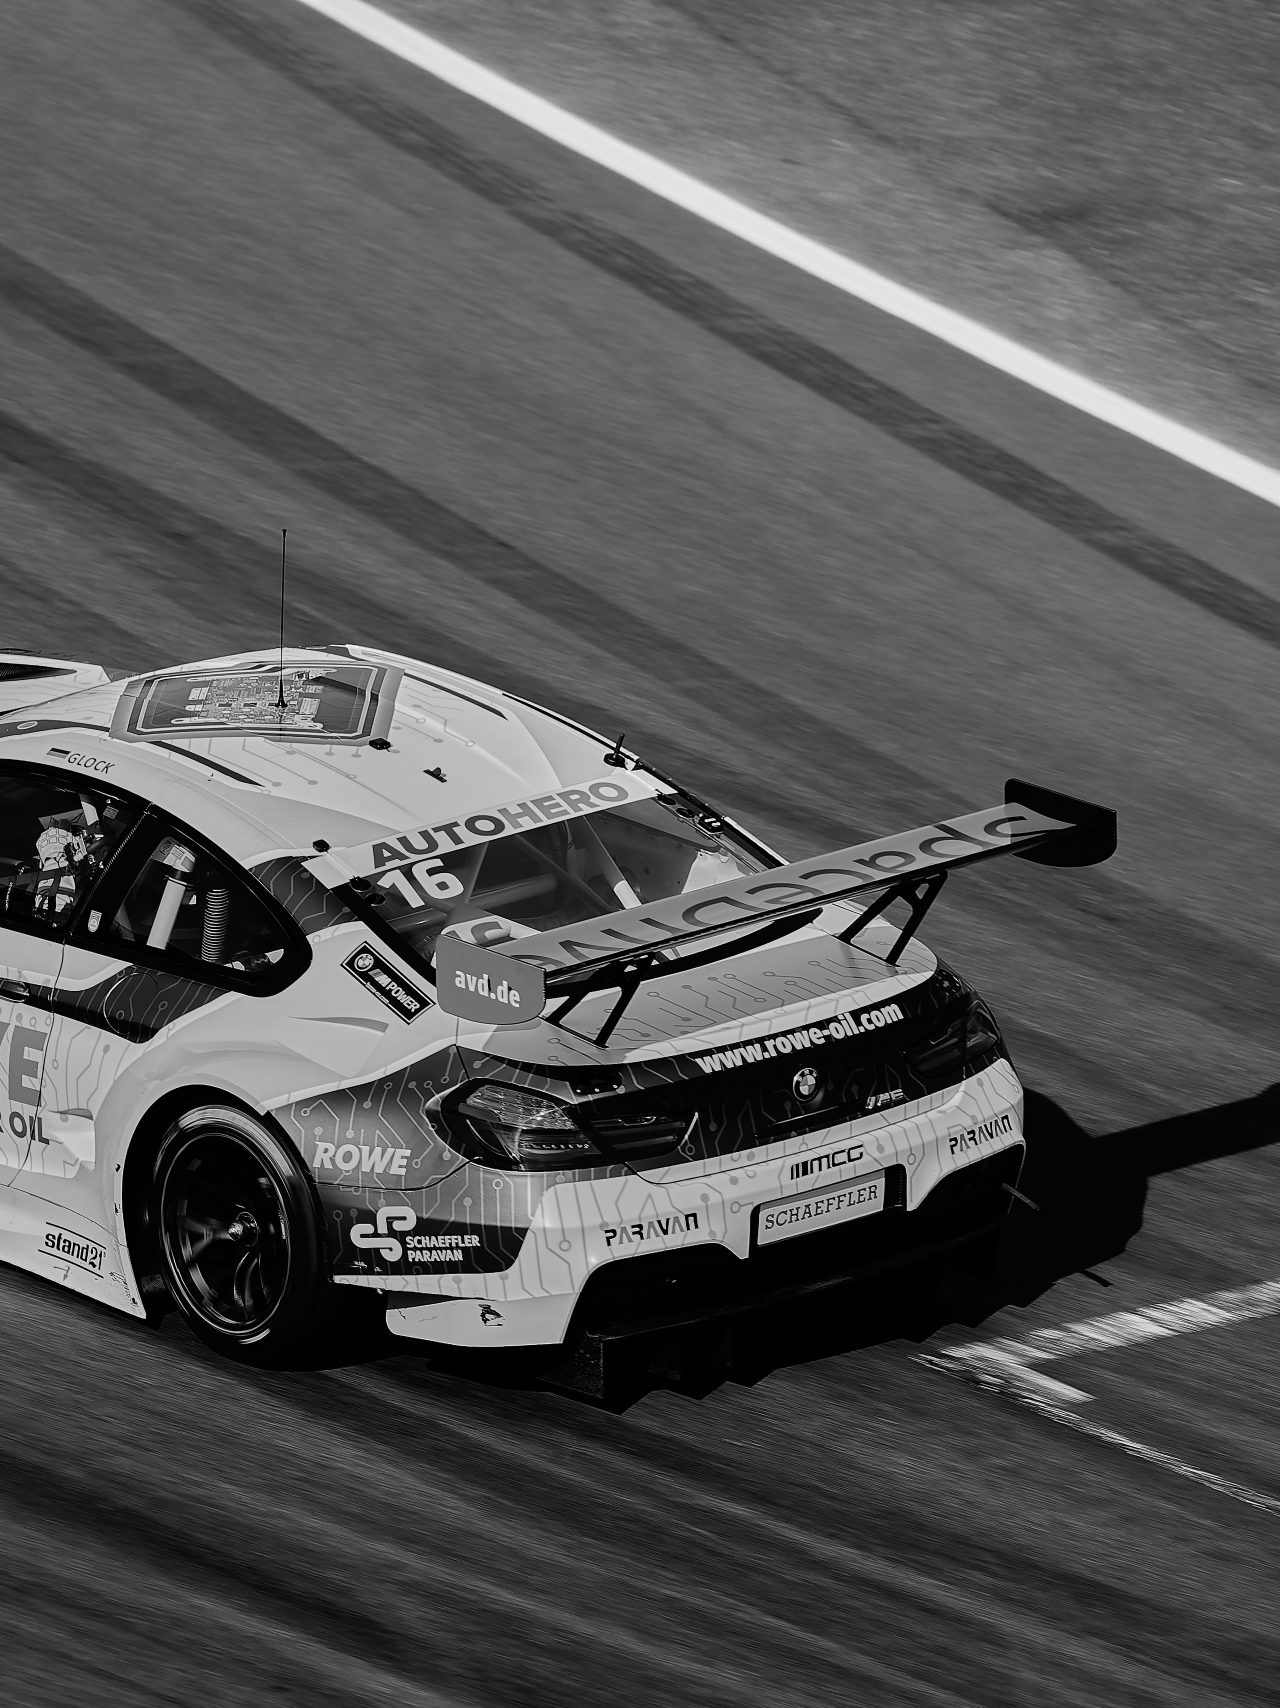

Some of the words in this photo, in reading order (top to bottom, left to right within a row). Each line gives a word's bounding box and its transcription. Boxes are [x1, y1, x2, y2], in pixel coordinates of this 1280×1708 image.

[68, 753, 115, 774] GLOCK
[371, 782, 629, 869] AUTOHERO
[377, 858, 465, 909] 16
[385, 981, 420, 1013] POWER
[455, 970, 520, 1008] avd.de
[695, 1002, 905, 1074] www.rowe-oil.com
[9, 1110, 51, 1146] OIL
[949, 1114, 1013, 1155] PARAVAN
[312, 1141, 412, 1176] ROWE
[764, 1183, 879, 1231] SCHAEFFLER
[405, 1234, 481, 1249] SCHAEFFLER
[604, 1211, 699, 1247] PARAVAN
[45, 1232, 103, 1271] stand21
[407, 1249, 463, 1263] PARAVAN
